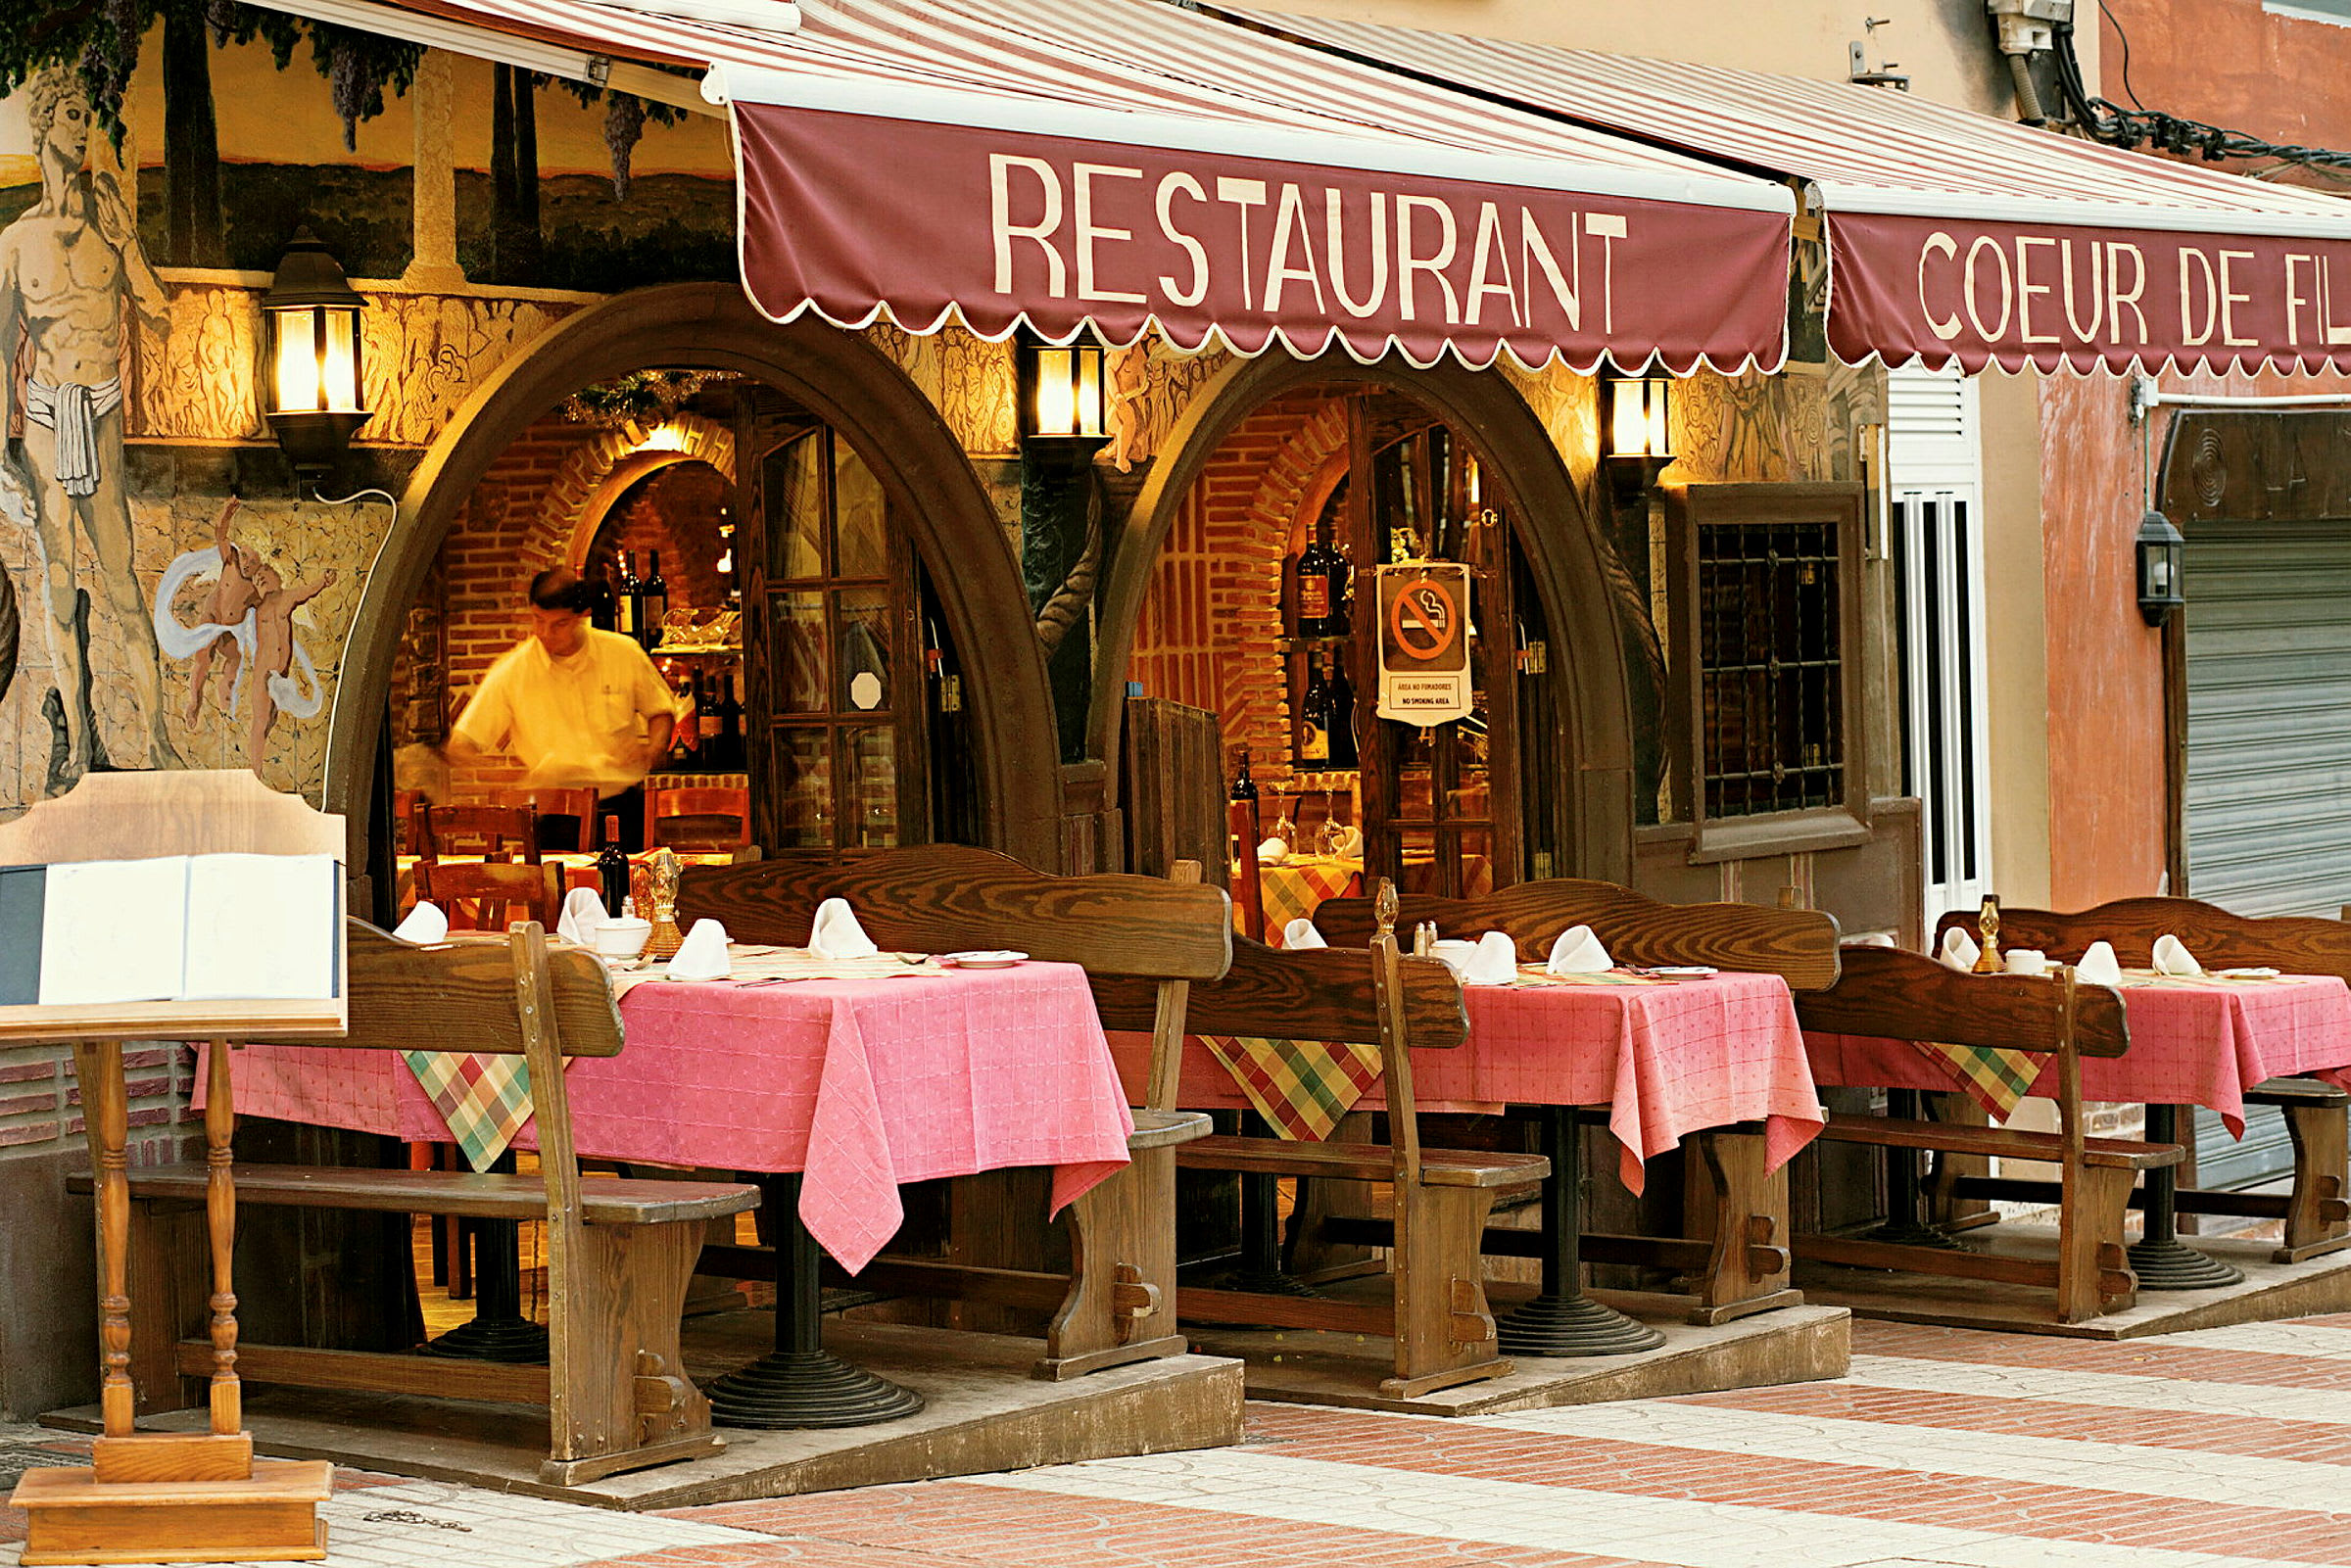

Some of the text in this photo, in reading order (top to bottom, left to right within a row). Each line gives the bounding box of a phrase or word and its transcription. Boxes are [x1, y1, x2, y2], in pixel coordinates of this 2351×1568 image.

[989, 153, 1627, 335] RESTAURANT
[1918, 231, 2351, 347] COEUR DE FIL
